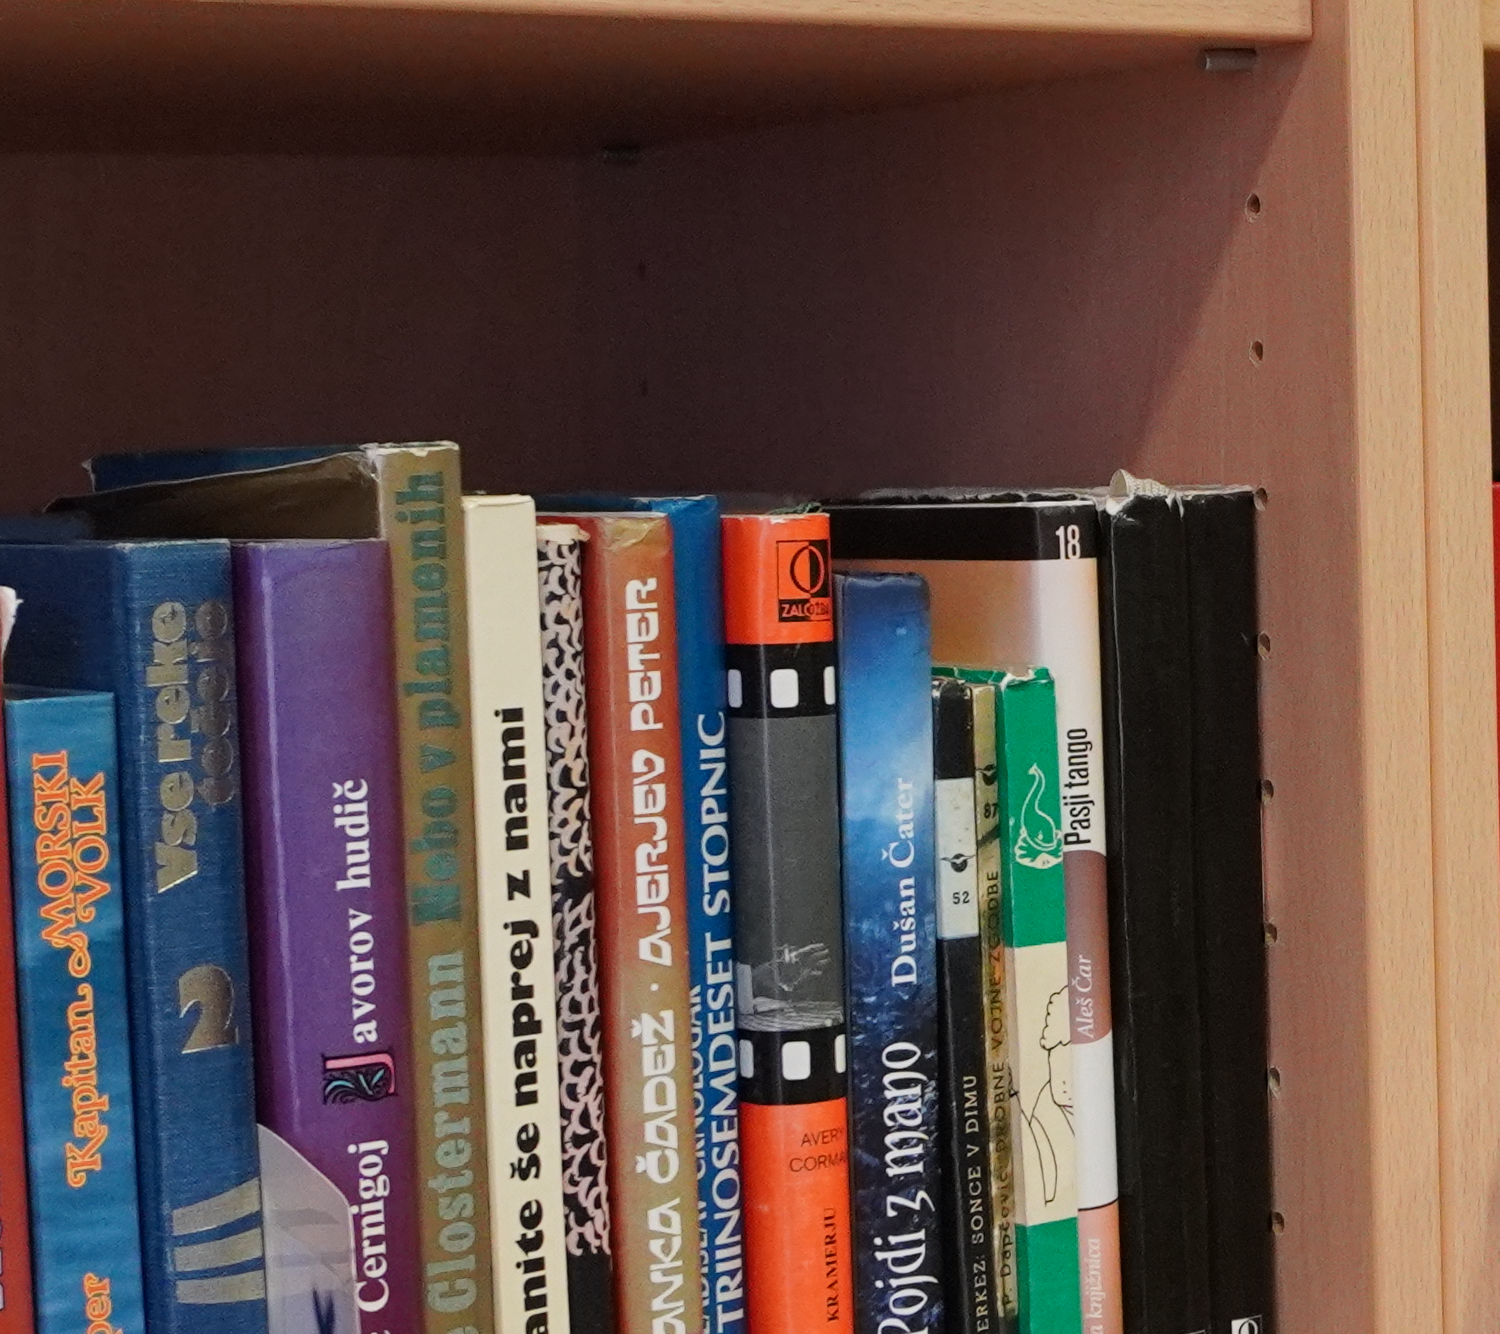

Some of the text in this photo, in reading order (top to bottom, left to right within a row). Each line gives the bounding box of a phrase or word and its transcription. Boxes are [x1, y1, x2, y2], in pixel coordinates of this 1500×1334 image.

[70, 772, 113, 923] VOLK
[332, 779, 376, 893] hudič
[492, 706, 533, 852] nami
[695, 710, 732, 915] STOPNIC
[1062, 727, 1093, 847] Pasji tango
[502, 869, 535, 900] z
[883, 776, 919, 986] Dušan Čater
[497, 917, 548, 1108] naprej
[505, 1120, 548, 1184] še
[878, 1037, 927, 1179] mano
[819, 1207, 841, 1323] KRAMERJU
